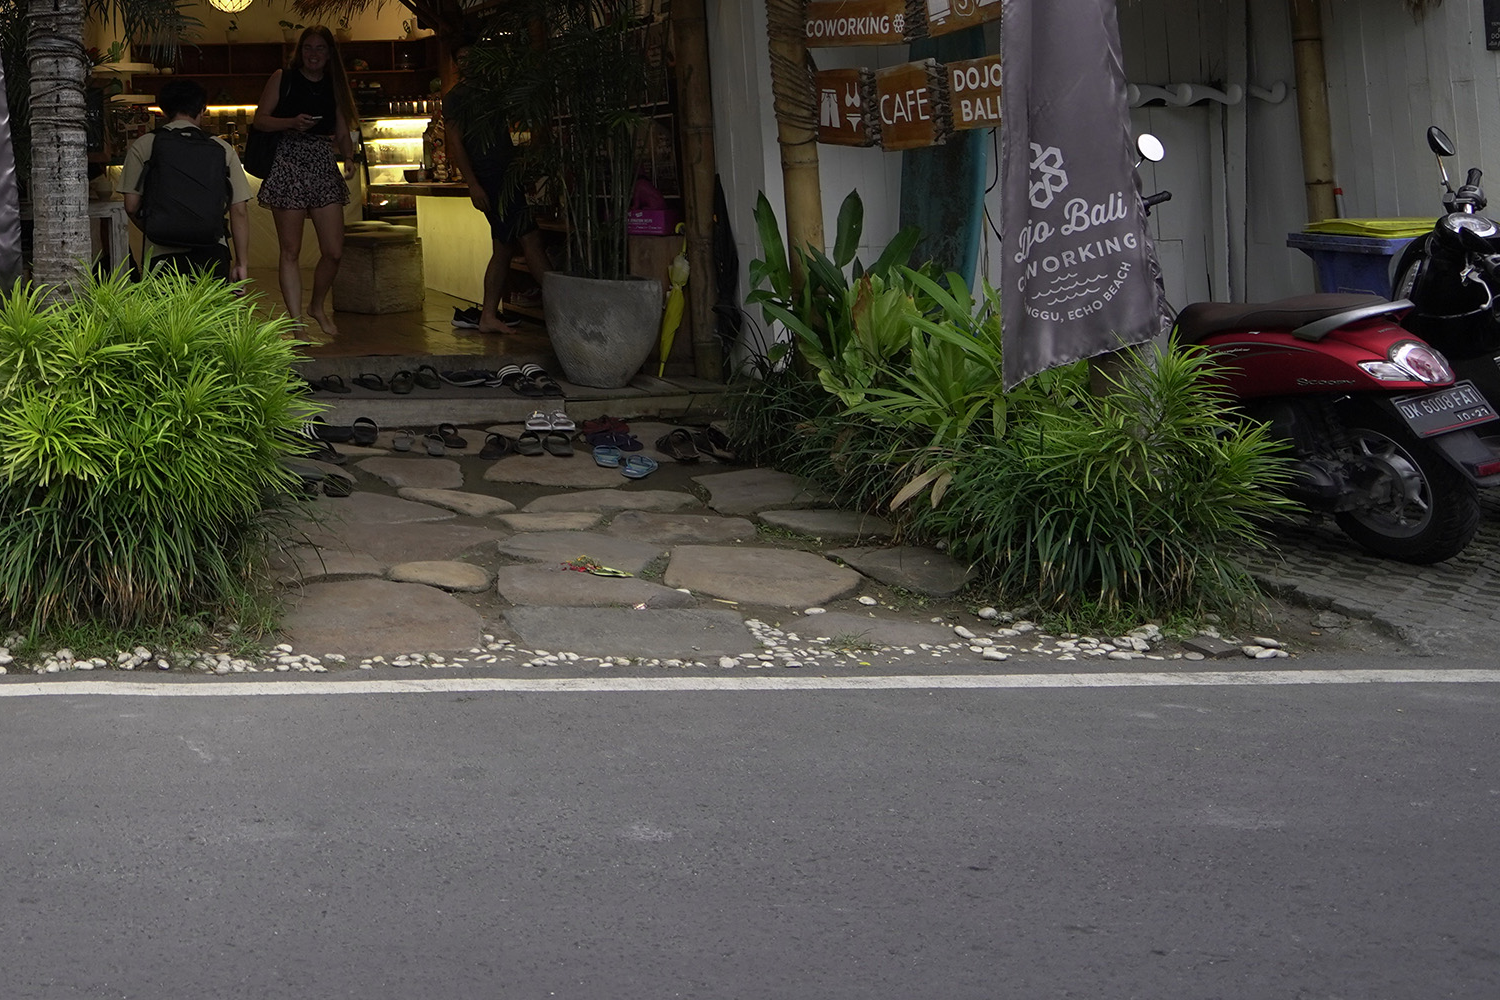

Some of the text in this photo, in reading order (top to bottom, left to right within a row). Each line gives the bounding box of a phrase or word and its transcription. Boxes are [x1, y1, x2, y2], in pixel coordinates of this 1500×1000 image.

[805, 15, 890, 38] COWORKING
[953, 63, 1003, 93] DOJO
[879, 87, 931, 125] CAFE
[960, 95, 1003, 123] BALI
[1060, 191, 1128, 236] Bali
[1017, 232, 1138, 292] CWORKING
[1067, 300, 1103, 321] ECHO
[1102, 261, 1132, 302] BEACH
[1400, 388, 1478, 419] DK 6008 FAT
